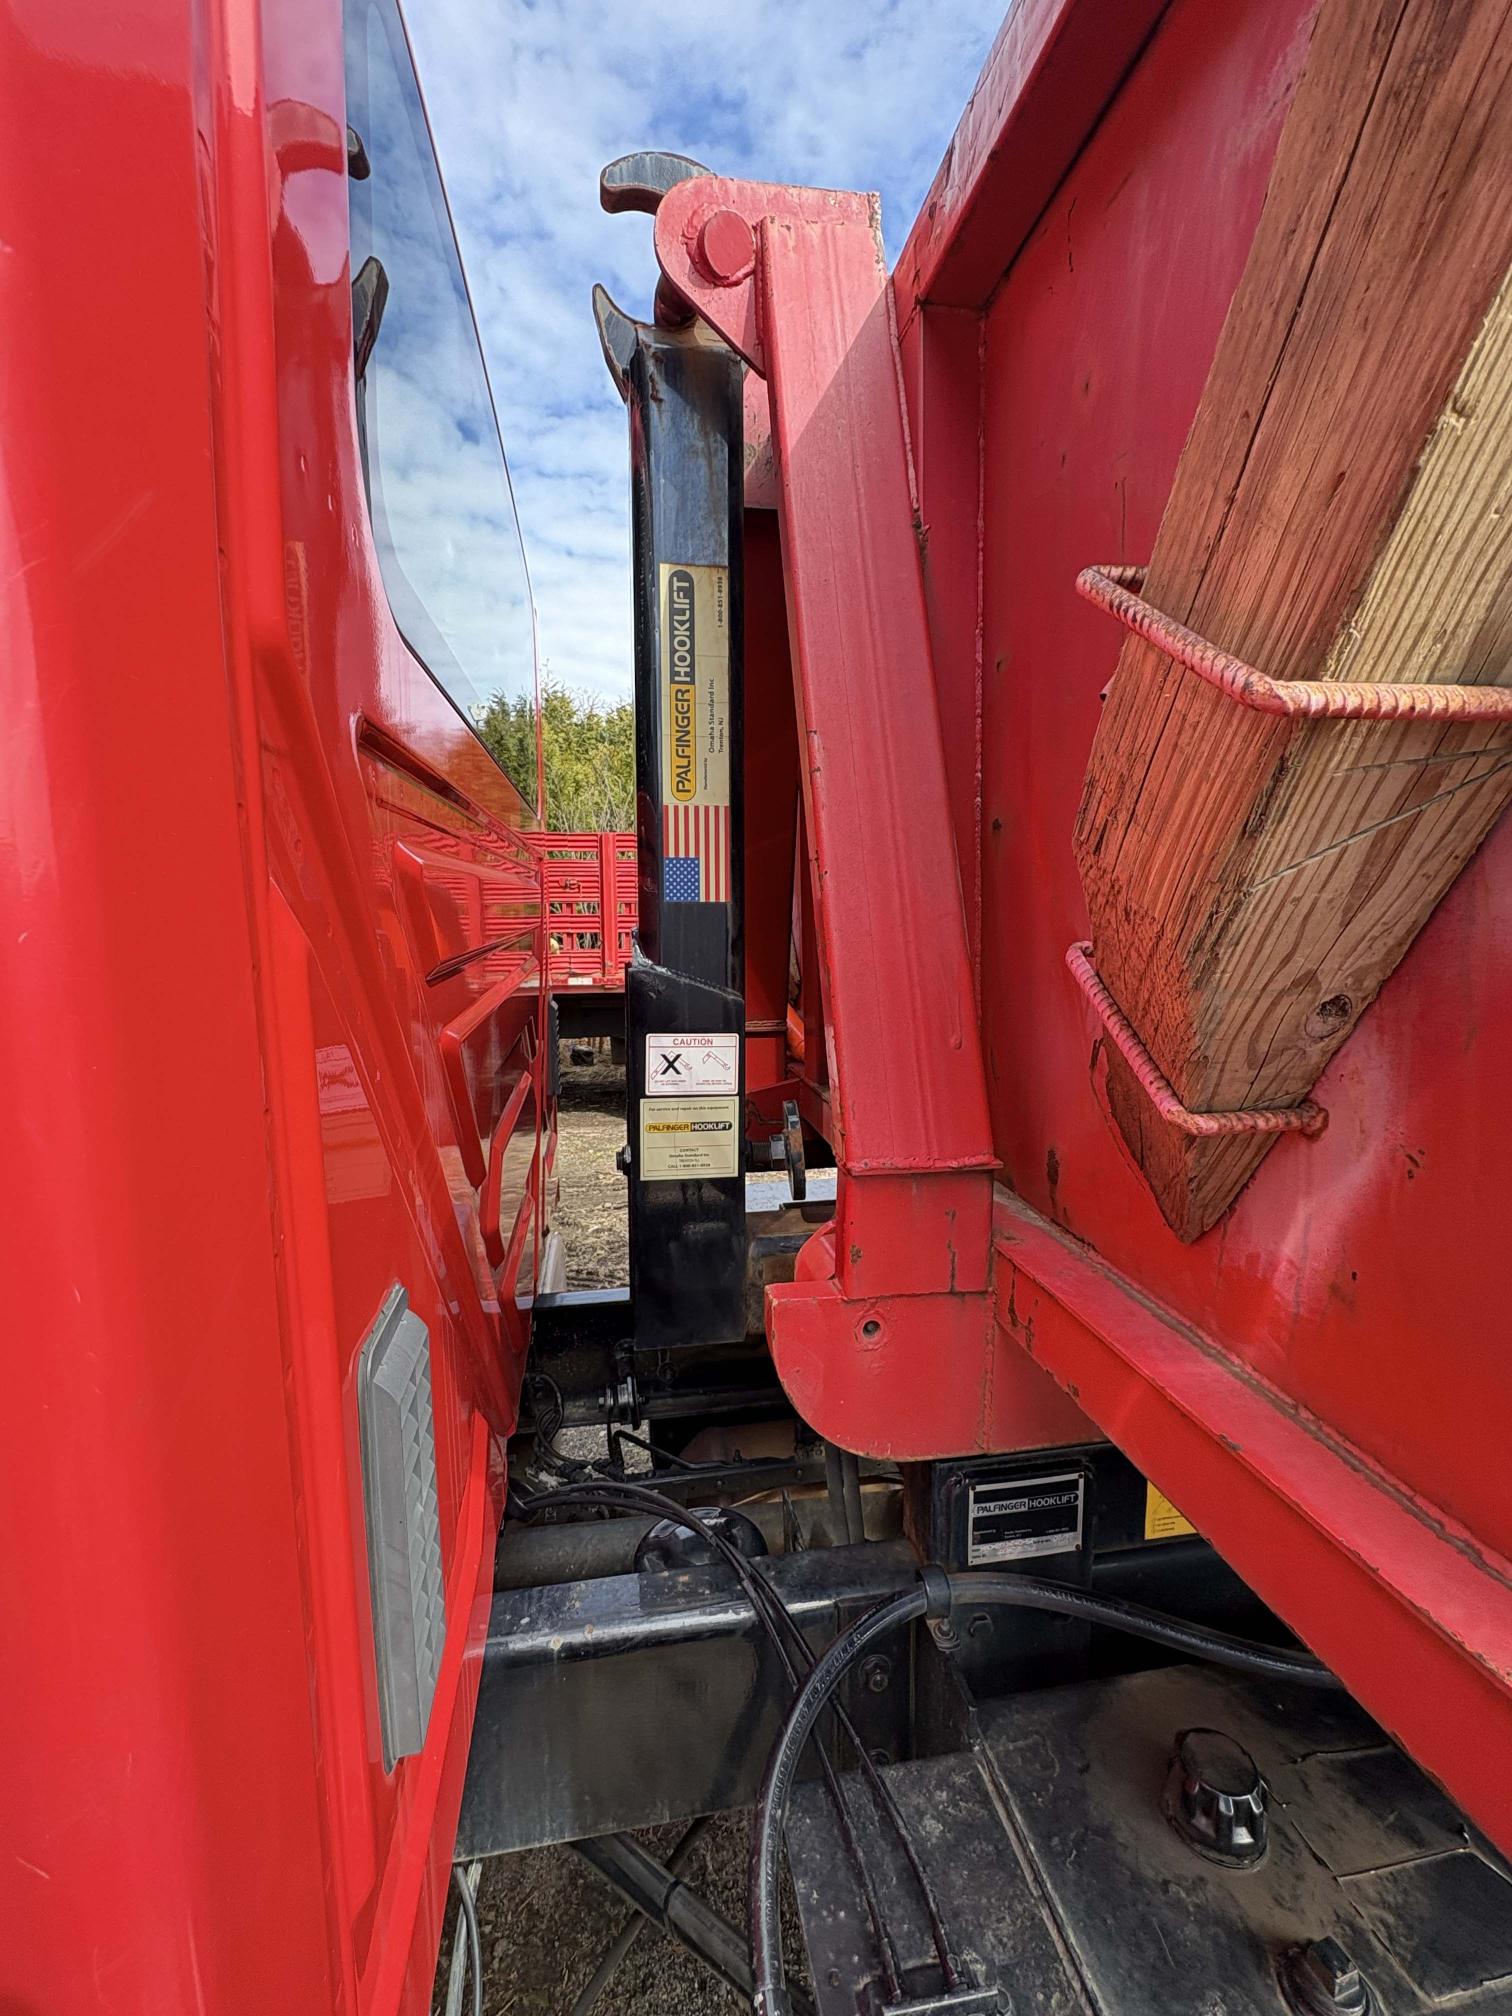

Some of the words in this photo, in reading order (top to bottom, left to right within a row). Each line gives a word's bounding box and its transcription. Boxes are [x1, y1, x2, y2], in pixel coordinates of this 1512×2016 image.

[673, 576, 691, 682] HOOKLIFT
[718, 717, 724, 726] NJ
[675, 688, 692, 793] PALFINGER
[672, 1037, 714, 1046] CAUTION
[648, 1124, 690, 1132] PALFINGER
[691, 1122, 730, 1131] HOOKLIFT
[976, 1501, 1027, 1515] PALFINGER
[1029, 1494, 1076, 1508] HOOKLIFT
